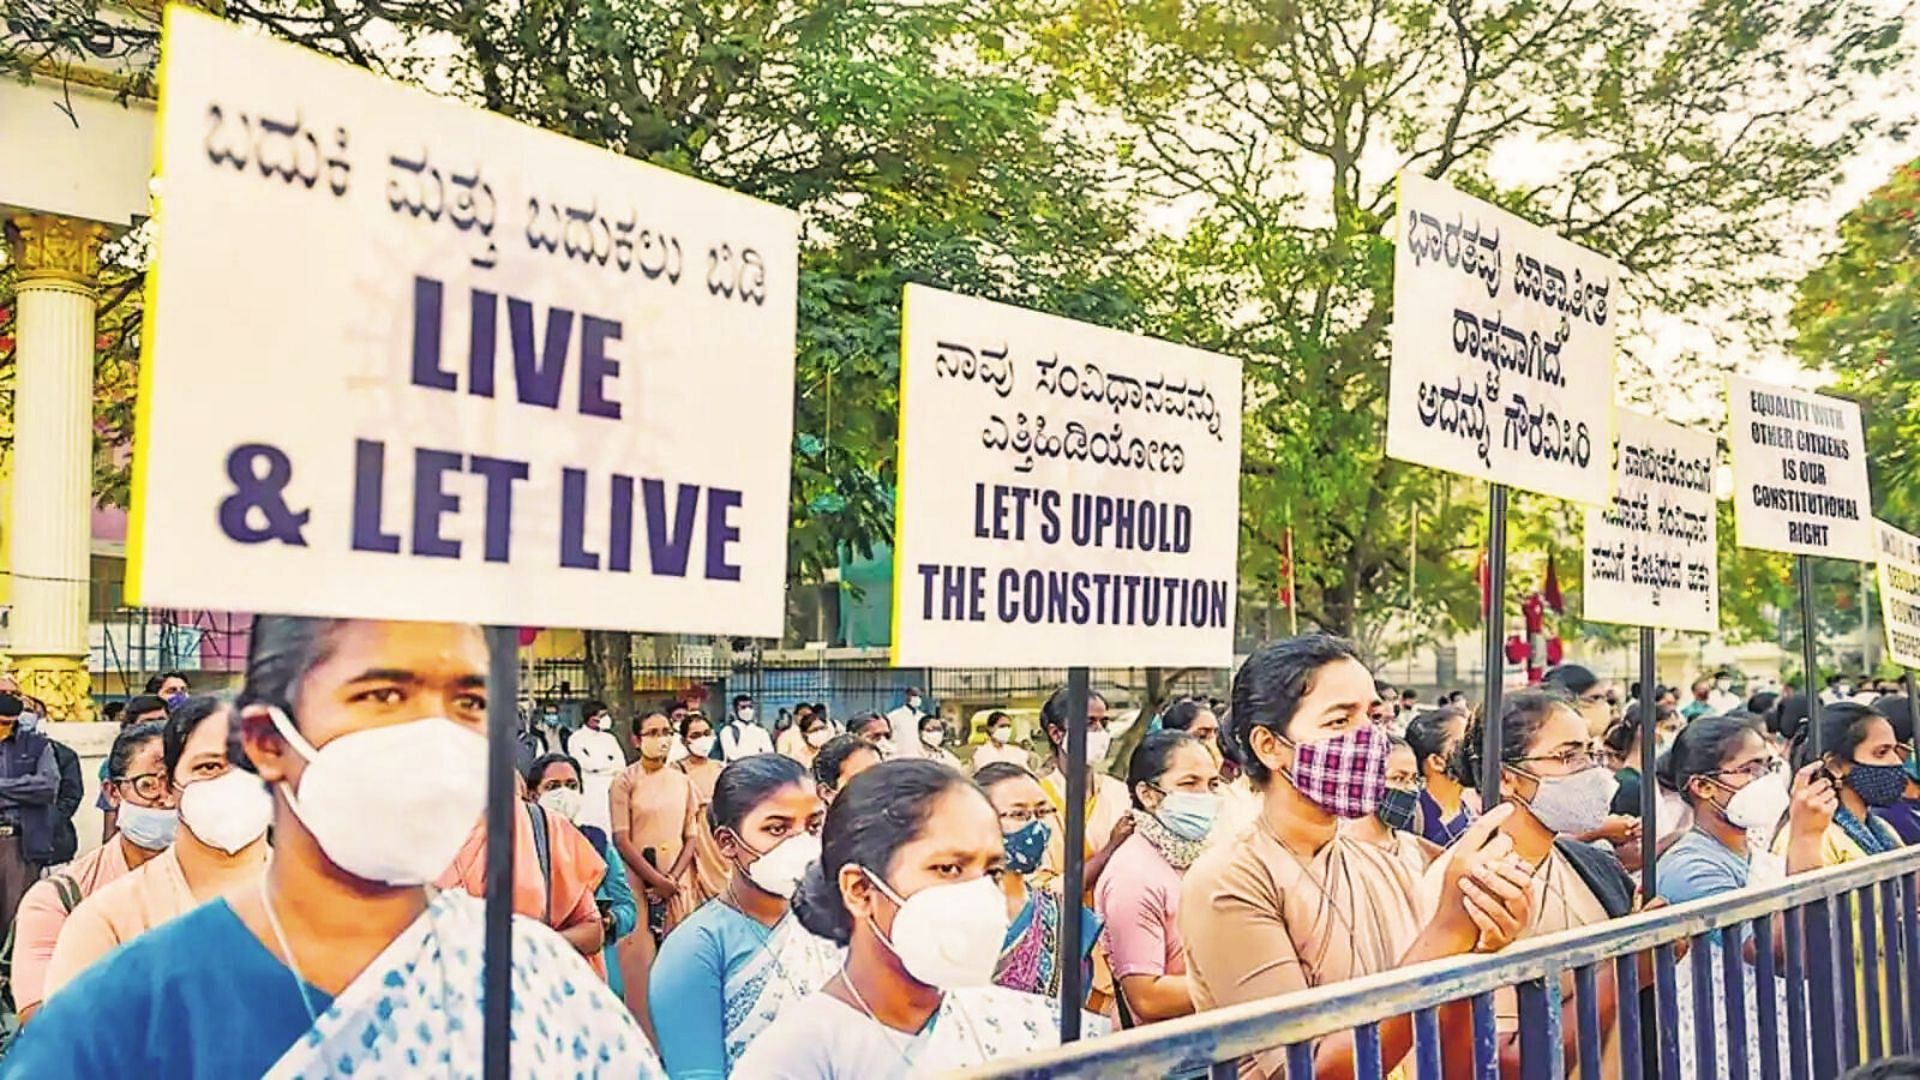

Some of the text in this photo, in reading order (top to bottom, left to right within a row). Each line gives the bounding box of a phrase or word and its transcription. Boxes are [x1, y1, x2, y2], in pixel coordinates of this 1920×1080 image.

[207, 102, 764, 306] ಬದುಕಿ ಮತ್ತು ಬದುಕಲು ಬಿಡಿ
[1408, 210, 1501, 298] ಭಾರತವು
[411, 275, 623, 420] LIVE
[935, 340, 1223, 441] ನಾವು ಸಂವಿಧಾನವನ್ನು
[1418, 377, 1491, 469] ಅದನ್ನು
[1503, 393, 1591, 469] ಗೌರವಿಸಿರಿ
[1750, 391, 1810, 422] EQUALITY
[982, 412, 1185, 474] ಎತ್ತಿಹಿಡಿಯೋಣ
[1751, 422, 1850, 460] OTHER CITIZENS
[1782, 457, 1827, 485] IS OUR
[218, 438, 742, 582] & LET LIVE
[975, 483, 1191, 554] LET'S UPHOLD
[1752, 484, 1860, 520] CONSTITUTIONAL
[1788, 521, 1829, 546] RIGHT
[918, 564, 1227, 628] THE CONSTITUTION
